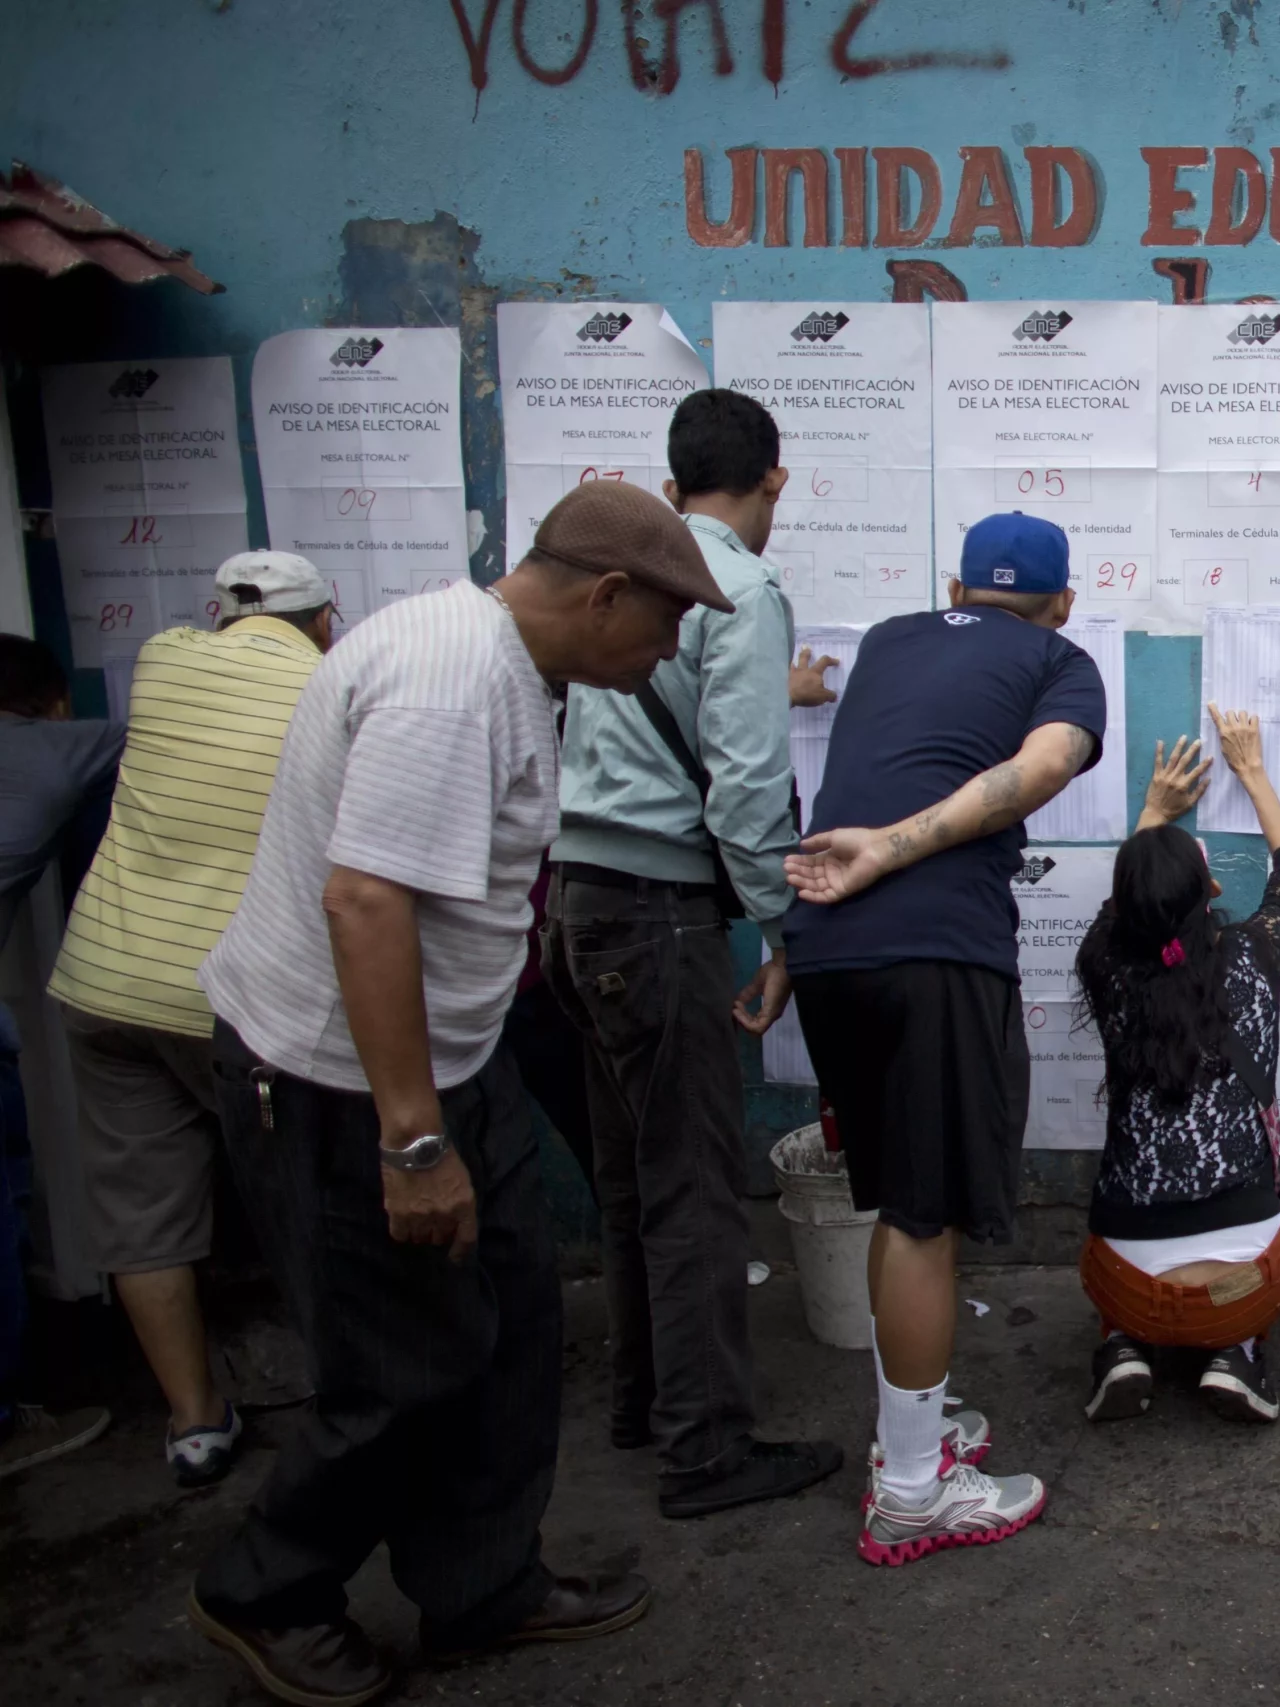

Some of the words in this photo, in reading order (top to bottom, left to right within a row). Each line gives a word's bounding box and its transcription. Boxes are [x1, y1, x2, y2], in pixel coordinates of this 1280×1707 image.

[684, 145, 1100, 248] UNIDAD
[516, 377, 556, 389] AVISO
[561, 378, 578, 390] DE
[583, 378, 695, 390] IDENTIFICACIÓN
[730, 379, 769, 390] AVISO
[774, 378, 792, 390] DE
[797, 378, 914, 391] IDENTIFICACIÓN
[948, 379, 989, 390] AVISO
[994, 379, 1013, 390] DE
[1018, 378, 1139, 390] IDENTIFICACIÓN
[1160, 383, 1203, 394] AVISO
[1208, 383, 1227, 394] DE
[527, 394, 544, 406] DE
[550, 395, 565, 406] LA
[570, 395, 603, 407] MESA
[764, 396, 778, 408] LA
[784, 396, 819, 408] MESA
[824, 396, 904, 409] ELECTORAL
[958, 396, 976, 408] DE
[982, 397, 999, 408] LA
[1004, 396, 1041, 408] MESA
[1046, 396, 1129, 408] ELECTORAL
[1171, 401, 1190, 412] DE
[1196, 401, 1213, 412] LA
[1218, 400, 1254, 412] MESA
[269, 402, 313, 414] AVISO
[317, 402, 334, 414] DE
[338, 402, 448, 414] IDENTIFICACIÓN
[282, 419, 302, 431] DE
[306, 420, 323, 431] LA
[327, 419, 359, 431] MESA
[363, 419, 440, 431] ELECTORAL
[812, 468, 833, 496] 6
[1018, 469, 1065, 496] 05
[1248, 472, 1261, 492] 4
[338, 488, 376, 520] 09
[120, 516, 162, 544] 12
[793, 521, 805, 531] de
[808, 521, 842, 531] Cédula
[846, 522, 858, 532] de
[861, 523, 906, 533] Identidad
[1084, 524, 1131, 534] Identidad
[1170, 528, 1223, 538] Terminales
[1227, 528, 1239, 538] de
[1242, 527, 1278, 538] Cédula
[292, 539, 340, 550] Terminales
[343, 540, 354, 550] de
[357, 540, 387, 550] Cédula
[391, 540, 403, 550] de
[406, 540, 448, 550] Identidad
[1097, 562, 1138, 588] 29
[100, 604, 133, 632] 89
